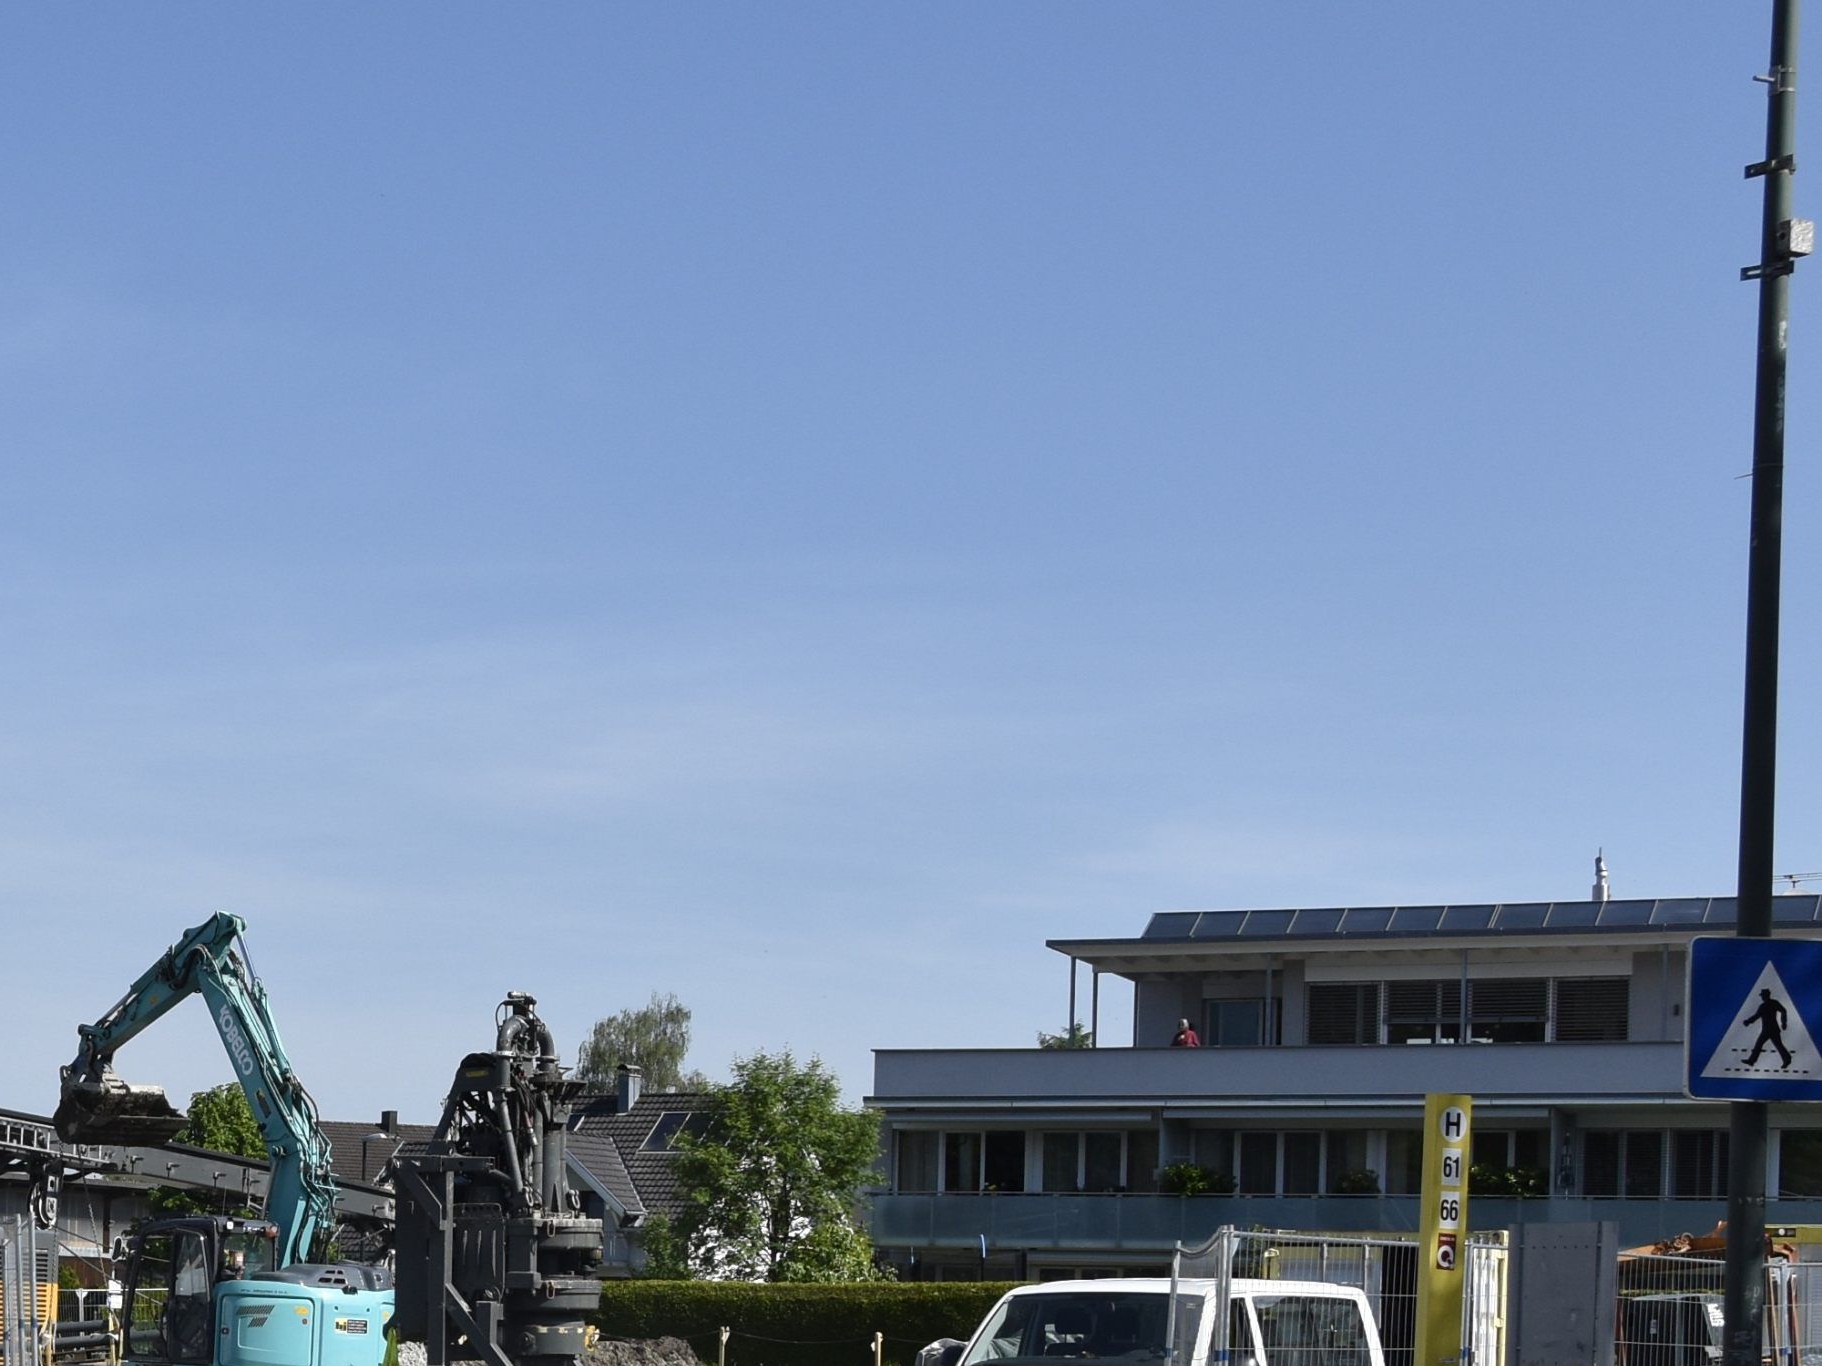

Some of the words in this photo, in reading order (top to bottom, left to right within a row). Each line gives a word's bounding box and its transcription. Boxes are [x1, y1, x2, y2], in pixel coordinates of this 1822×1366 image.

[219, 1003, 254, 1076] KOBELCO
[1445, 1111, 1461, 1137] H
[1443, 1156, 1460, 1178] 61
[1440, 1199, 1459, 1221] 66
